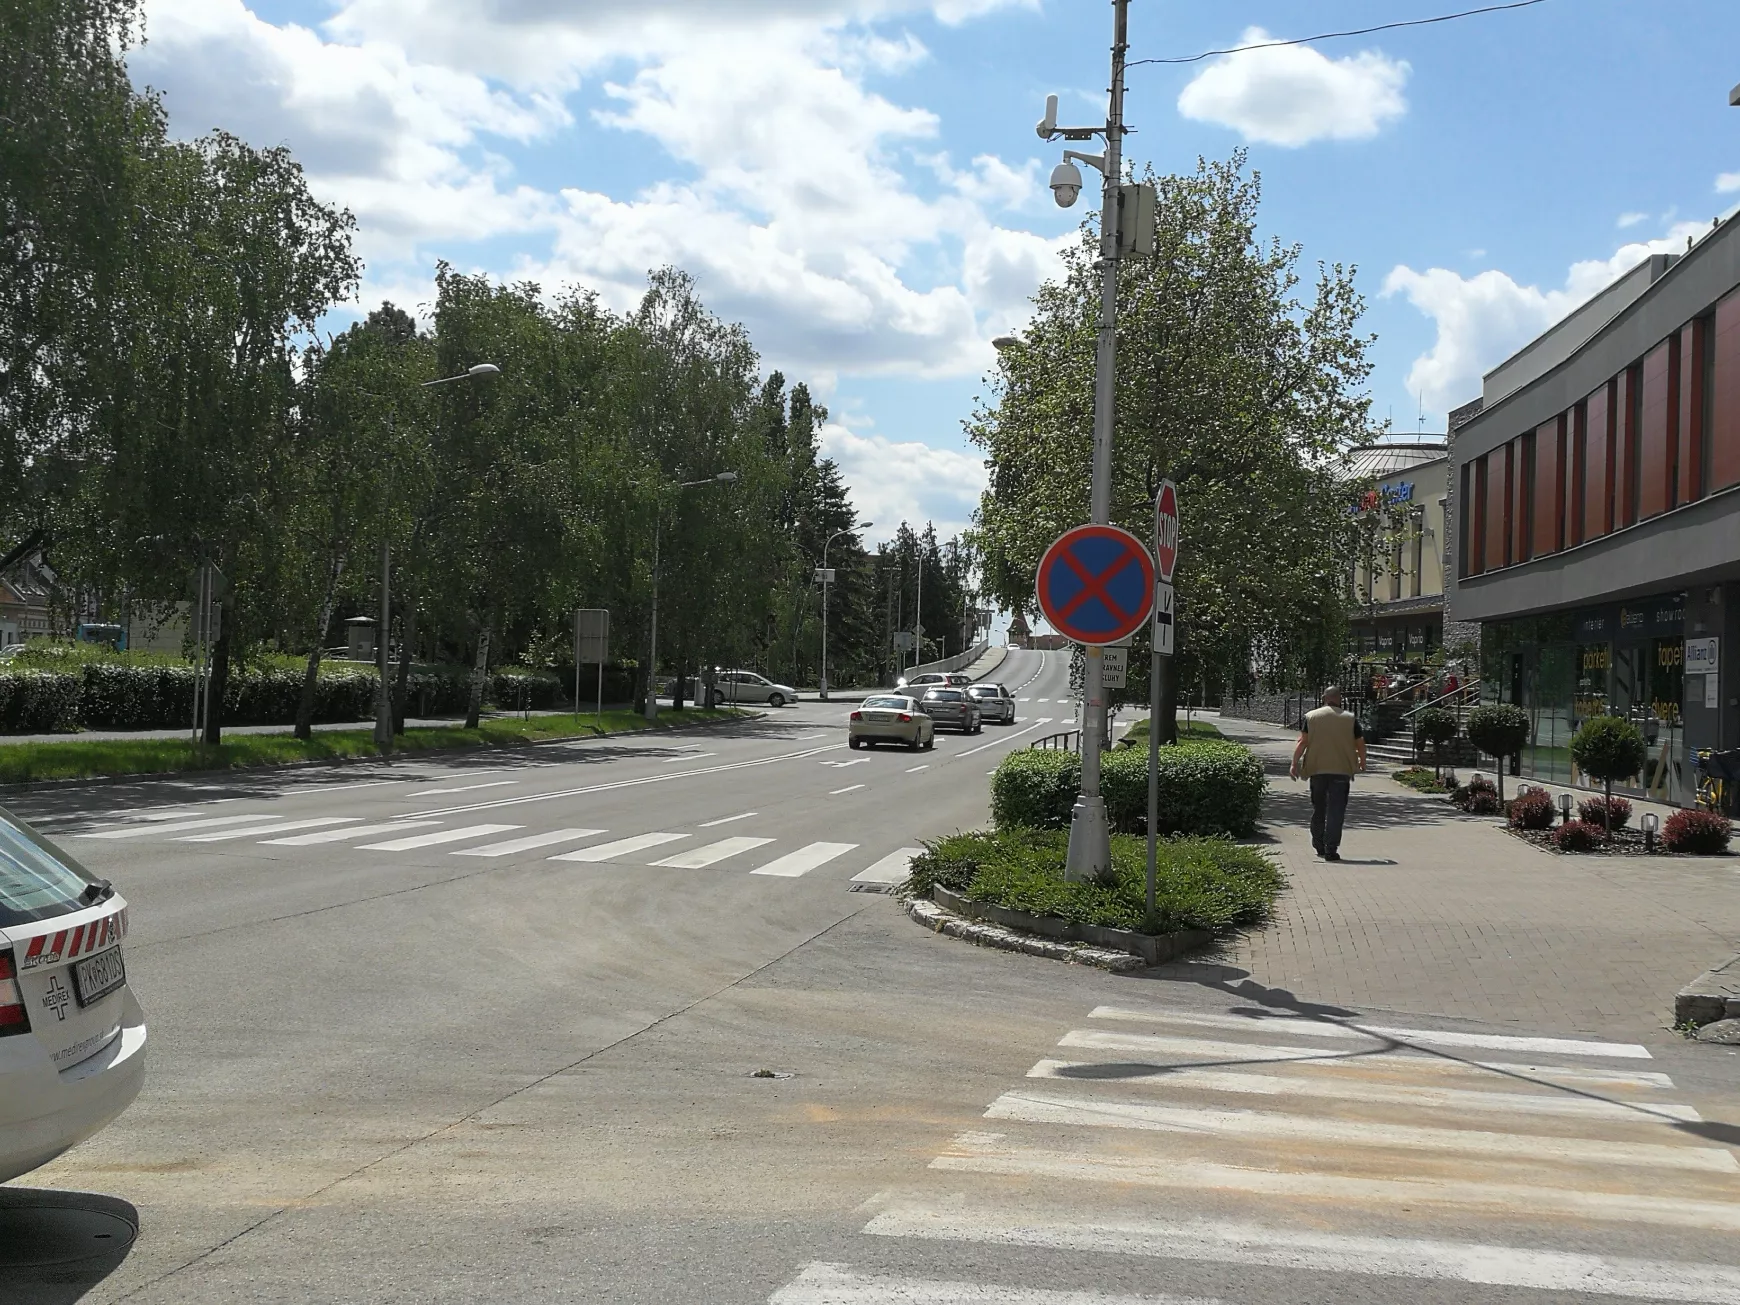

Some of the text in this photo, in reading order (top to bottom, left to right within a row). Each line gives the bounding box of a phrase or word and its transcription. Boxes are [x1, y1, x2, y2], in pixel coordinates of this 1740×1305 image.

[1159, 511, 1176, 550] STOP
[1656, 608, 1686, 623] showroo
[1658, 641, 1684, 673] tapet
[1687, 645, 1707, 661] Allianz
[42, 989, 70, 1007] MEDIREX
